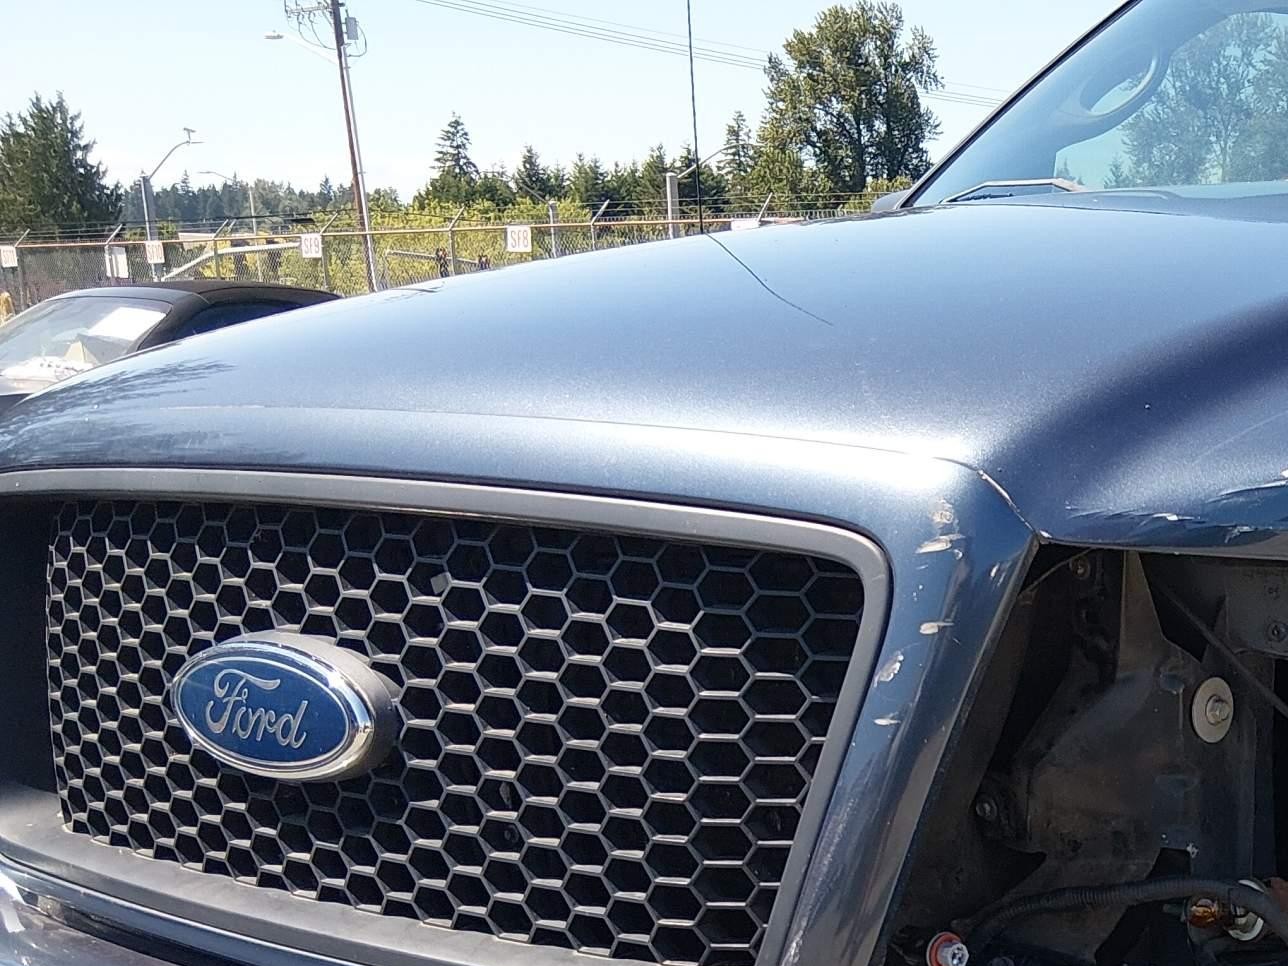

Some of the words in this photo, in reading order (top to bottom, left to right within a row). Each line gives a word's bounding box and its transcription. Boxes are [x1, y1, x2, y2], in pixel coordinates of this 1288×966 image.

[303, 237, 320, 255] SF9
[510, 229, 529, 249] SF8
[205, 668, 308, 749] Ford
